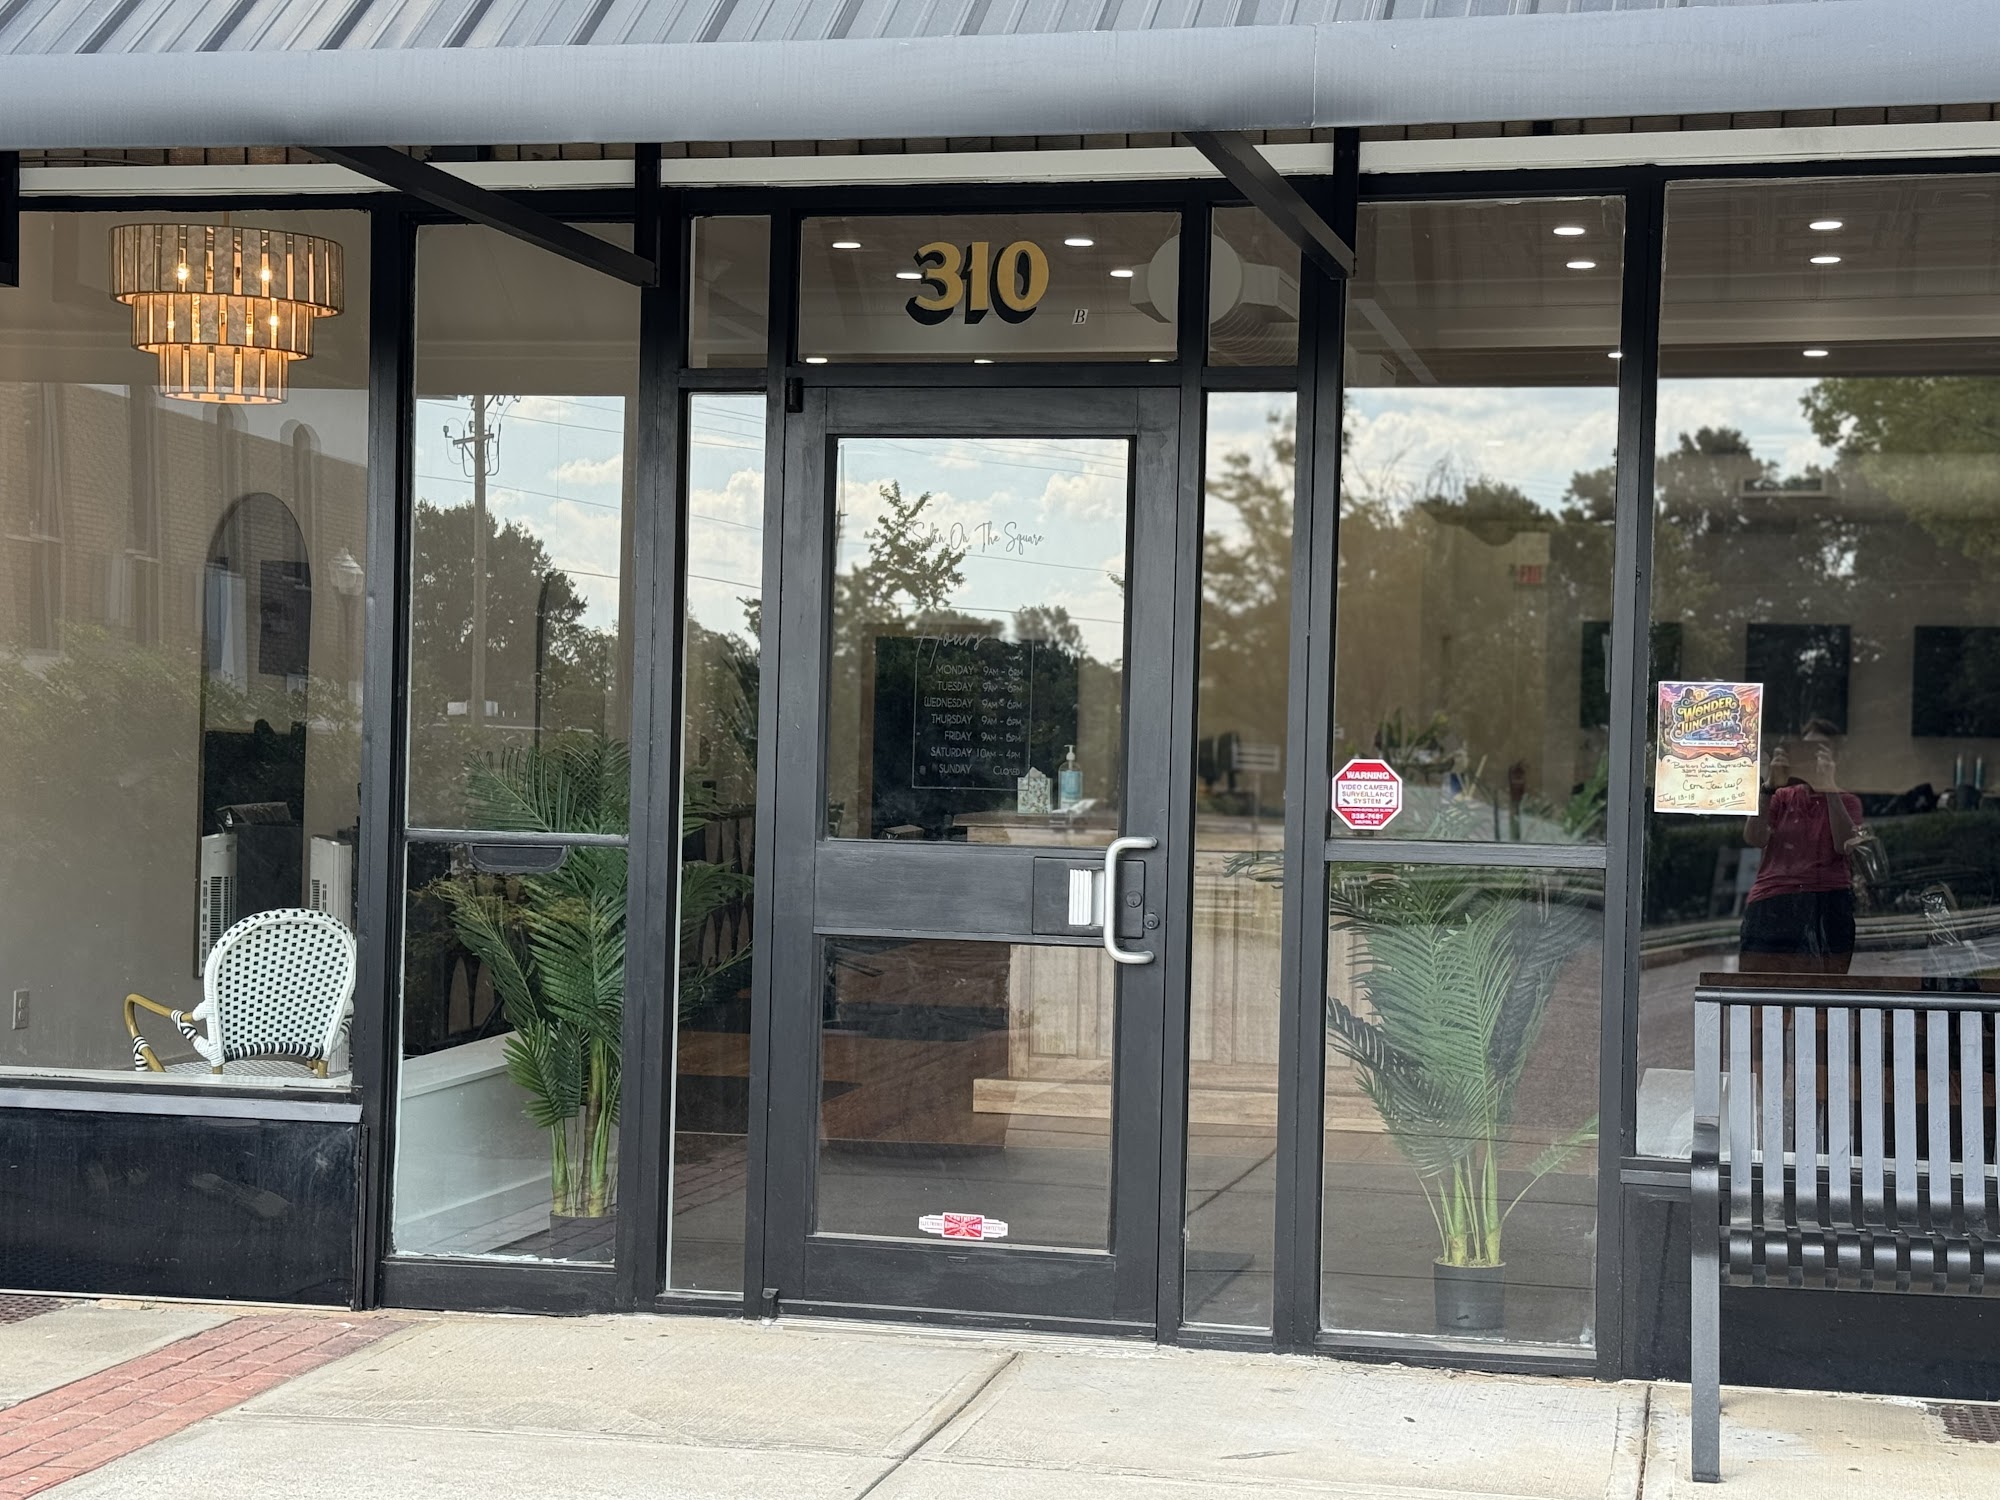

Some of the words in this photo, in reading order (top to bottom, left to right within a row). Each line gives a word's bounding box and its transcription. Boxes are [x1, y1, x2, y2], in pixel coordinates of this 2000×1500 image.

[906, 240, 1049, 325] 310
[1073, 309, 1088, 325] B
[951, 522, 970, 550] On
[974, 521, 1000, 553] The
[1003, 521, 1044, 555] Square
[936, 665, 974, 675] MONDAY
[937, 681, 974, 691] TUESDAY
[924, 696, 973, 708] WEDNESDAY
[1677, 697, 1737, 721] WONDER
[931, 714, 973, 725] THURSDAY
[1675, 709, 1731, 738] JUNCTION
[944, 731, 972, 741] FRIDAY
[930, 747, 972, 757] SATURDAY
[938, 764, 972, 774] SUNDAY
[1346, 771, 1390, 780] WARNING
